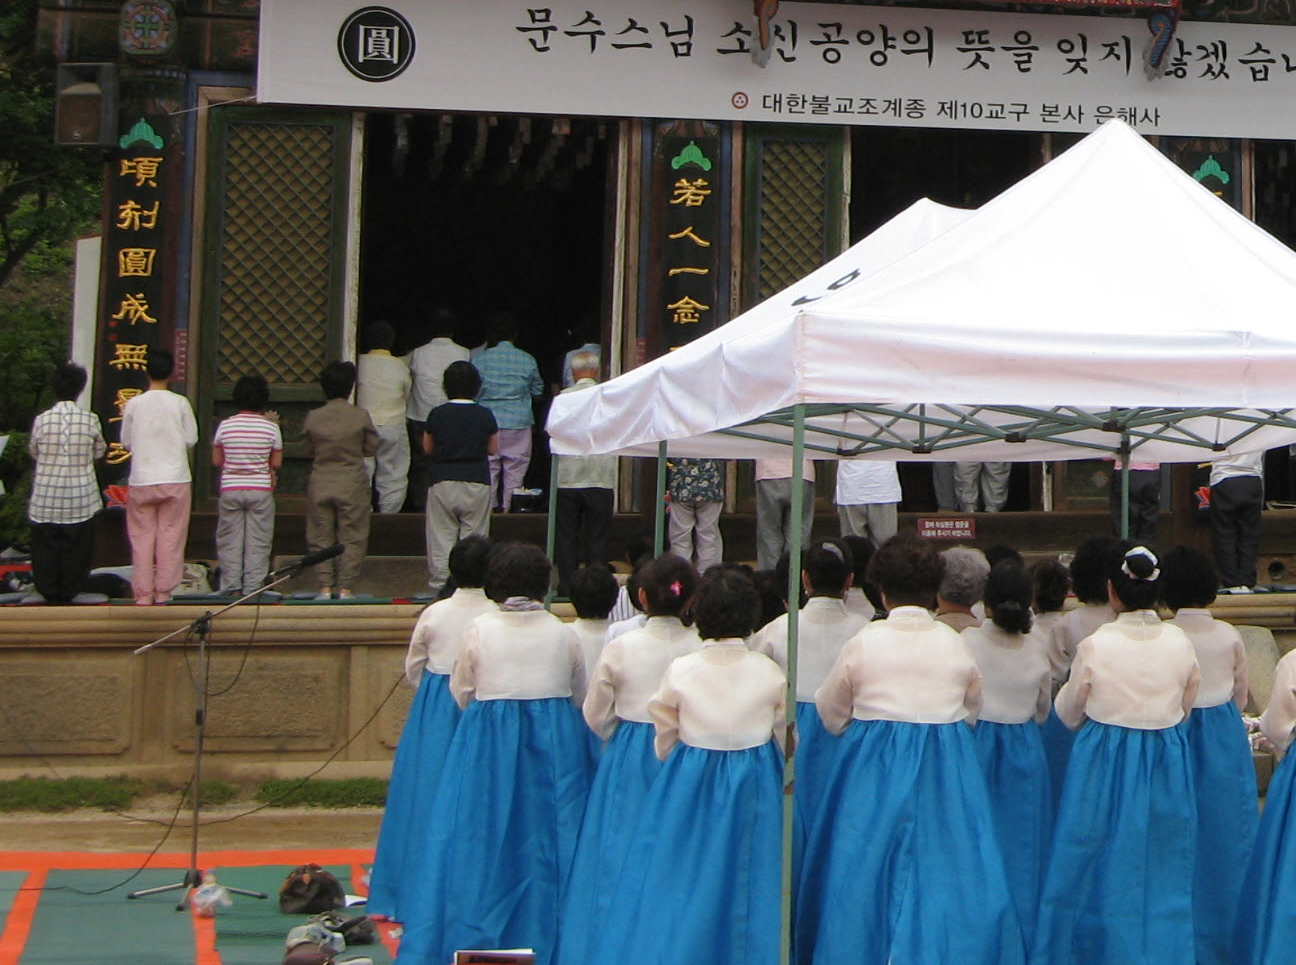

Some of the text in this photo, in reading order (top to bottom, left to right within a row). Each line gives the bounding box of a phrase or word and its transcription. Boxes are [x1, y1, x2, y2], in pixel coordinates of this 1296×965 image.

[515, 7, 694, 58] 문수스님
[716, 19, 934, 67] 소신공양의
[956, 28, 1040, 74] 뜻을
[1057, 32, 1132, 77] 잊지
[762, 93, 1161, 128] 대한불교조계종 제10교구 본사 은해사
[666, 178, 712, 352] 若人一念
